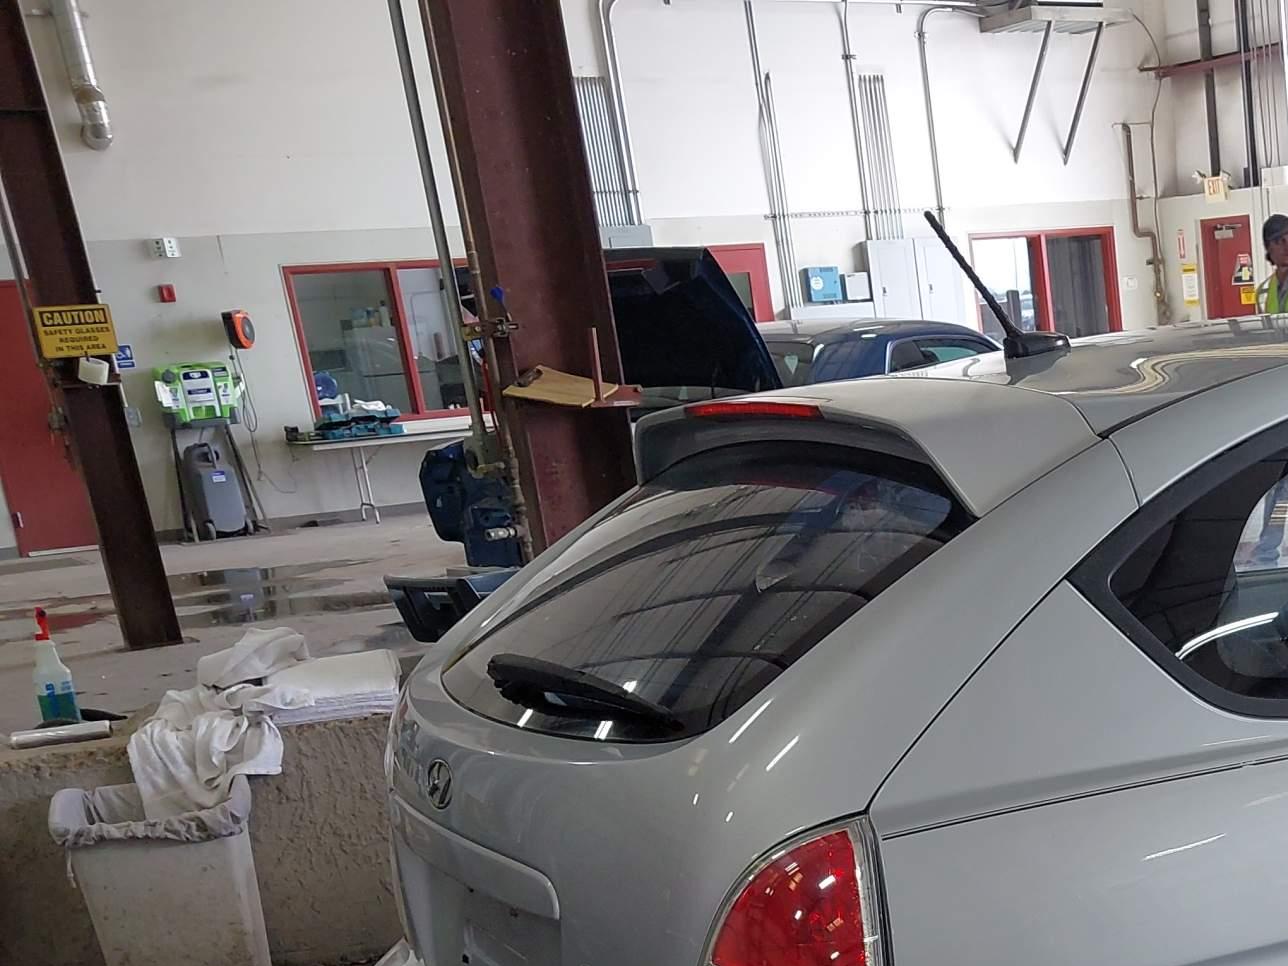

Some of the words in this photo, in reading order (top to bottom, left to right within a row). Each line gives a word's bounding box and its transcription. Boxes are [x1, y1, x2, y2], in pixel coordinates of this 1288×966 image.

[42, 309, 106, 326] CAUTION
[43, 328, 73, 336] SAFETY
[75, 326, 110, 335] GLASSES
[59, 335, 100, 343] REQUIRED
